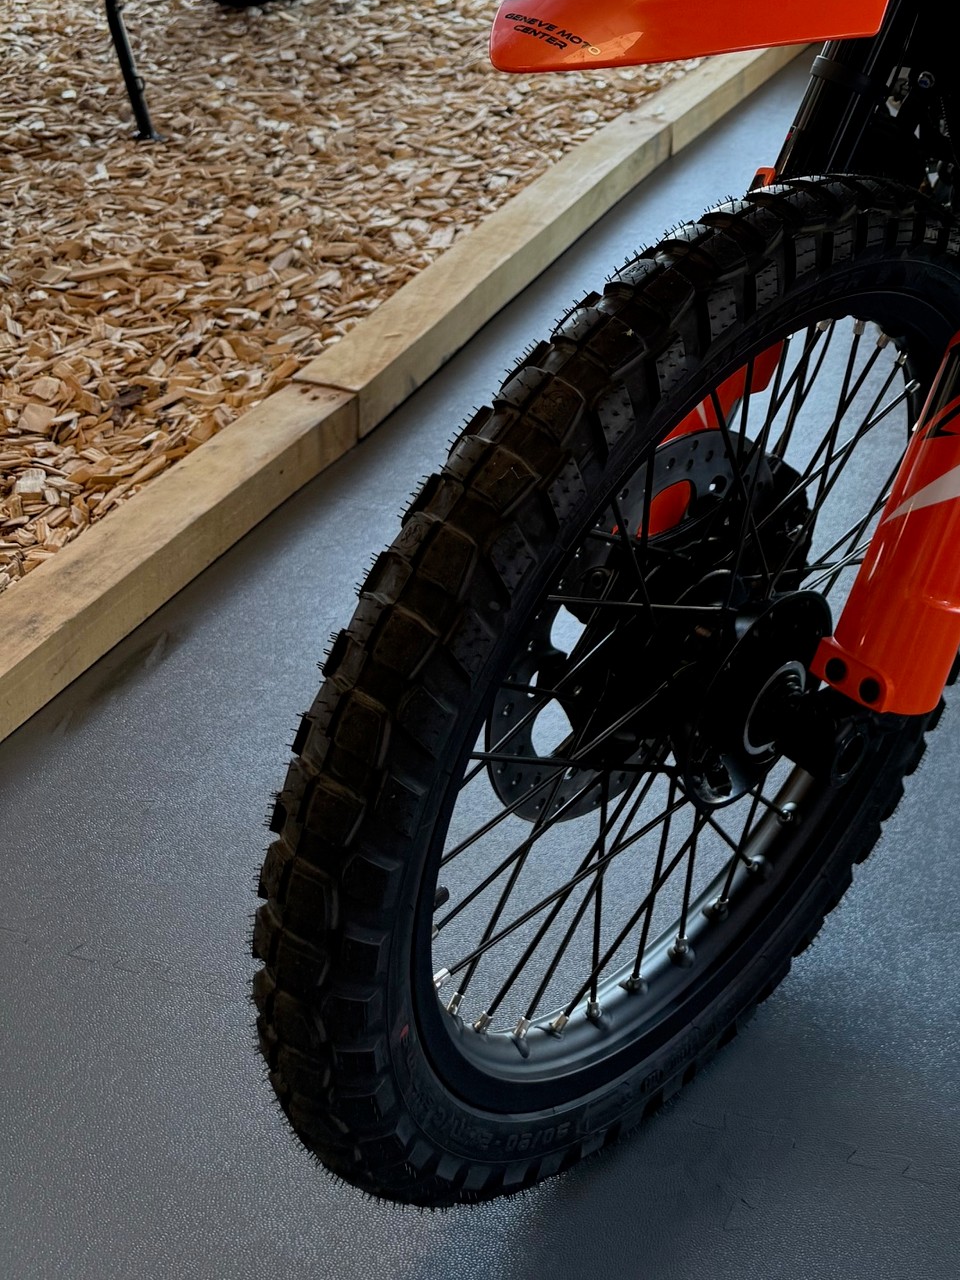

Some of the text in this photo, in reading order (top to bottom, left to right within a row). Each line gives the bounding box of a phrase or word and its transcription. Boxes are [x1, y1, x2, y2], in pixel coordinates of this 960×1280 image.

[504, 12, 602, 56] GENEVE MOTO
[513, 24, 568, 50] CENTER
